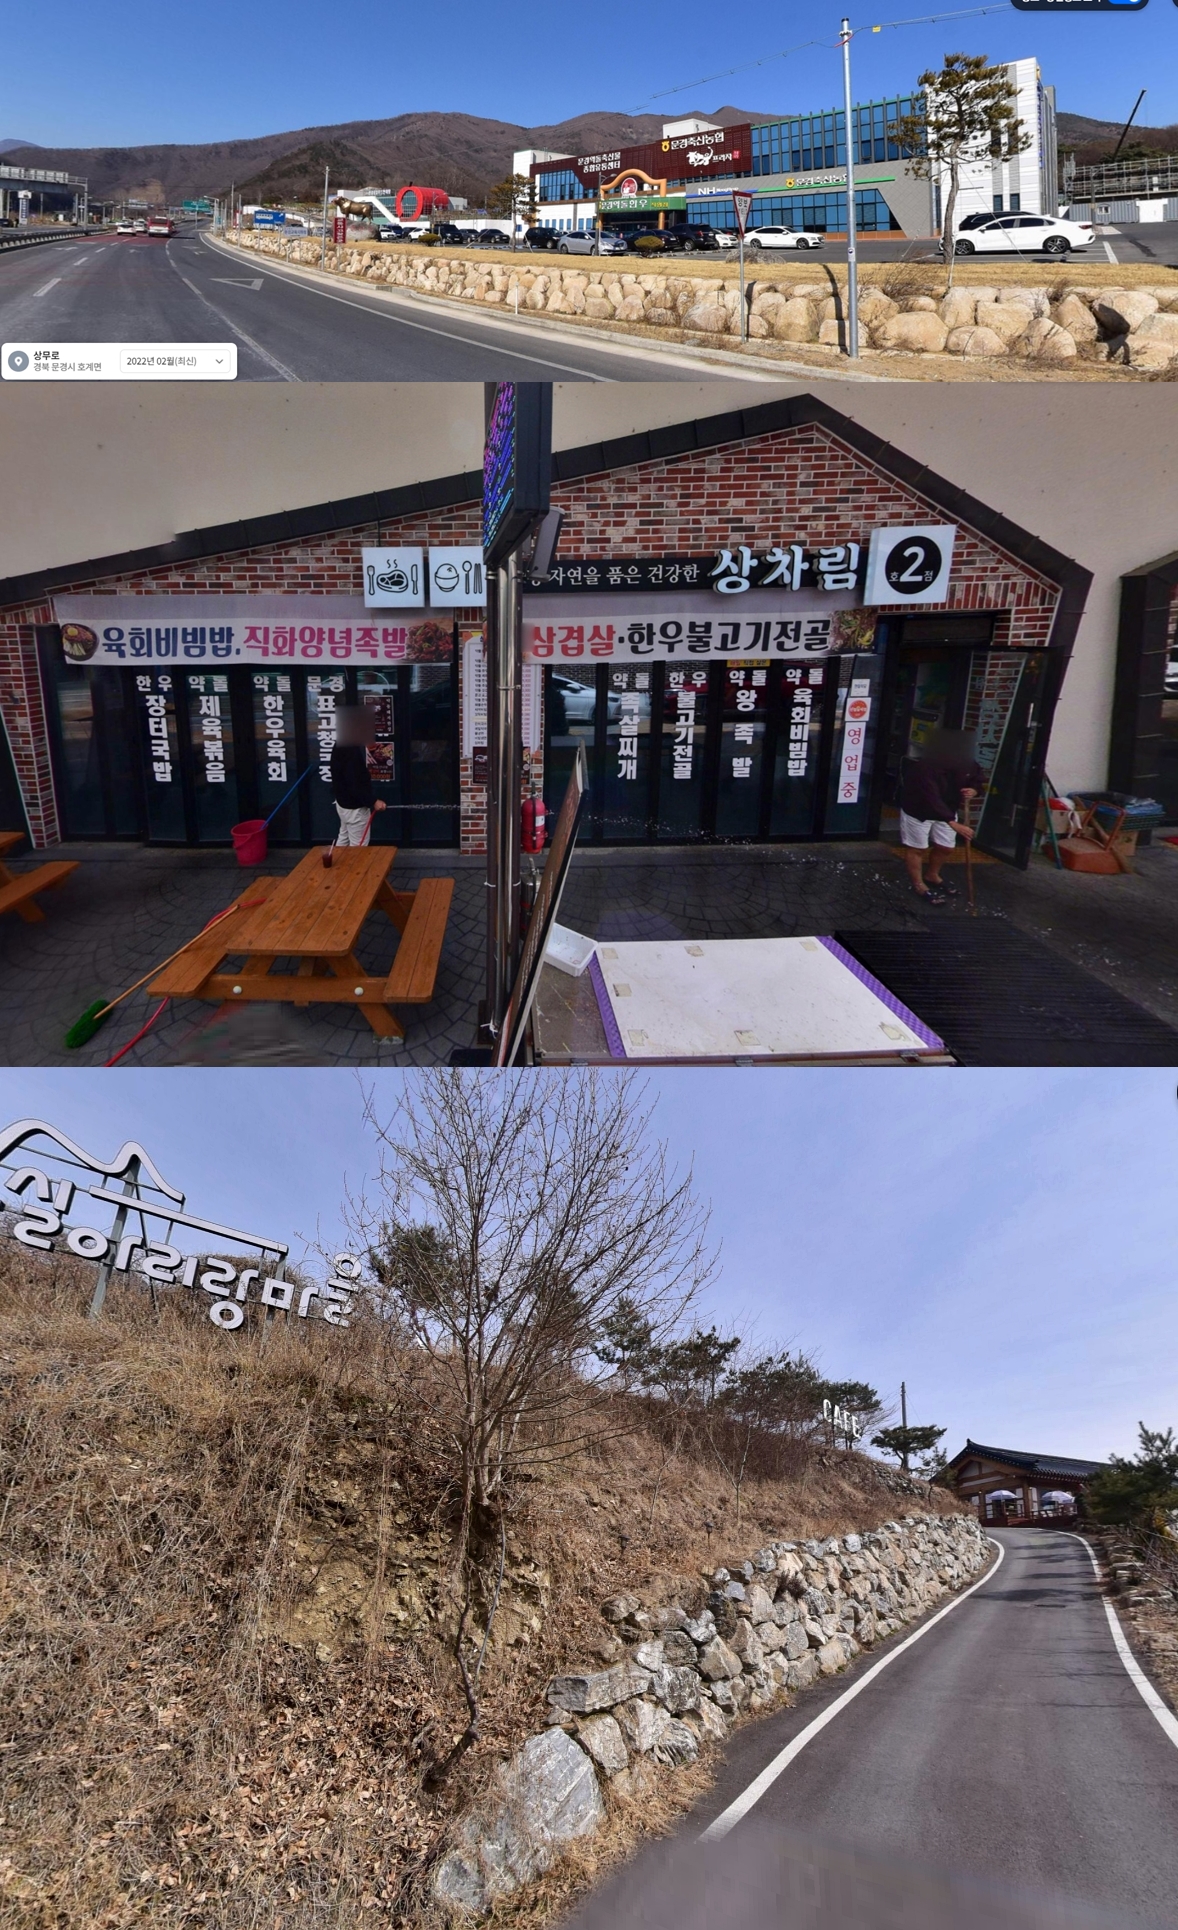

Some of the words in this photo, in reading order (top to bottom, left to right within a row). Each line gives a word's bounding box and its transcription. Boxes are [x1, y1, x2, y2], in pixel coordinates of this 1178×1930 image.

[671, 132, 724, 150] 문경축산농협
[583, 160, 621, 174] 종합유통센터
[698, 187, 715, 196] NH
[737, 197, 748, 208] 양보
[549, 566, 601, 586] 자연을
[606, 565, 642, 585] 품은
[647, 563, 700, 584] 건강한
[708, 542, 861, 595] 상차림
[136, 675, 172, 692] 한우
[188, 675, 229, 692] 약돌
[253, 675, 291, 692] 약돌
[612, 672, 650, 689] 약돌
[669, 671, 707, 688] 한우
[729, 669, 767, 687] 약돌
[785, 668, 824, 685] 약돌
[145, 695, 173, 782] 장터국밥
[199, 695, 226, 783] 제육볶음
[263, 695, 288, 782] 한우육회
[672, 691, 696, 780] 불고기전골
[787, 688, 813, 777] 육회비빔밥
[0, 1166, 362, 1331] 실아리랑마을
[823, 1399, 861, 1438] CAFE
